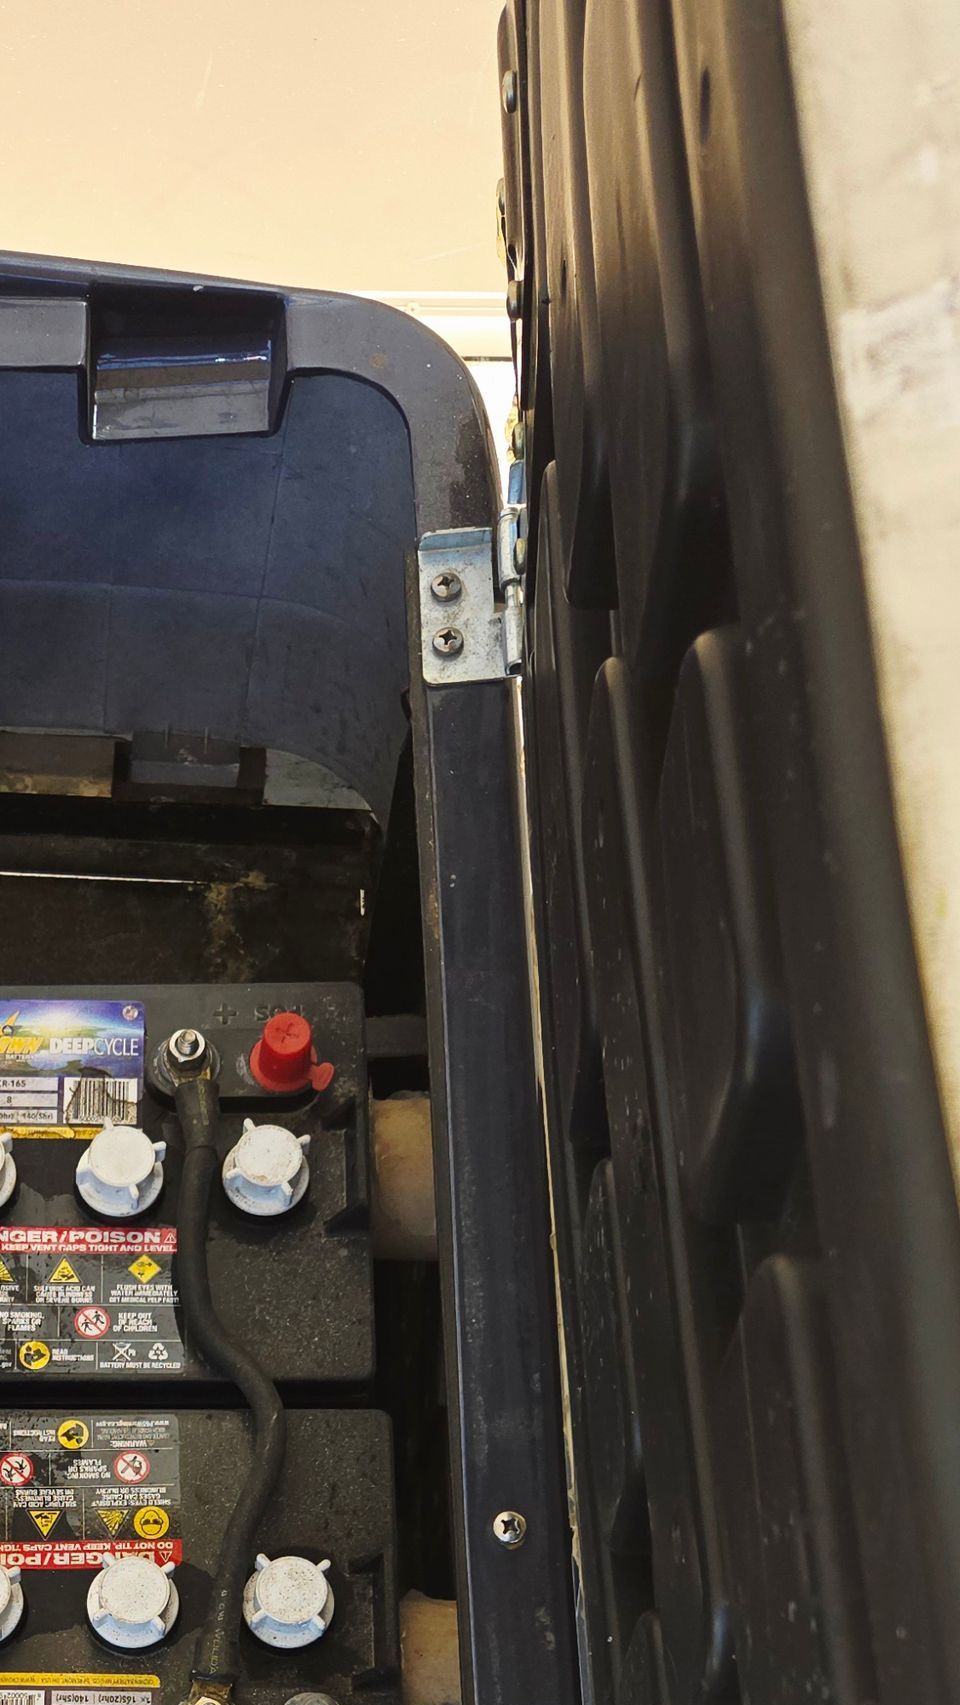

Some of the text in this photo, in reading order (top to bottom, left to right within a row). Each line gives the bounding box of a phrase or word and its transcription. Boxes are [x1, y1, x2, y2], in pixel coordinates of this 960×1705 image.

[49, 1037, 139, 1056] DEEPCYCLE
[2, 1243, 28, 1251] KEEP
[58, 1244, 86, 1252] CAPS
[88, 1244, 119, 1252] TIGHT
[120, 1244, 142, 1252] AND
[144, 1244, 177, 1252] LEVEL.
[0, 1311, 9, 1319] NO
[113, 1542, 132, 1550] TIP.
[134, 1542, 155, 1550] NOT
[56, 1693, 136, 1704] 165(20hr) 140(5hr)
